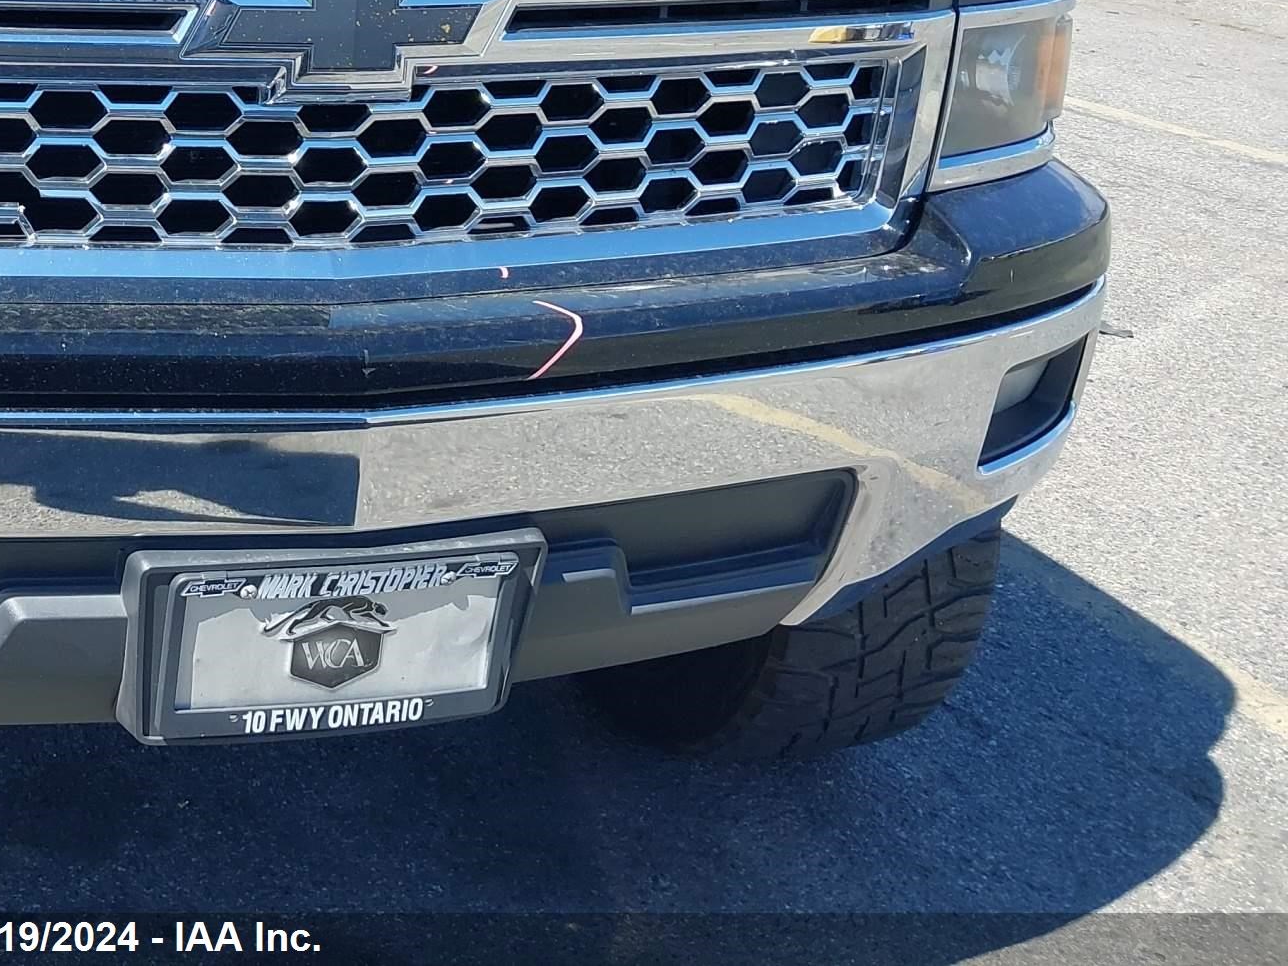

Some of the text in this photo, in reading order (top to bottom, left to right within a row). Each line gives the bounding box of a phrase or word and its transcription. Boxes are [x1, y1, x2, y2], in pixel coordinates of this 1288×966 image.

[465, 565, 510, 574] CHEVROLET
[190, 582, 239, 593] CHEVROLET
[256, 573, 317, 599] MARK
[302, 638, 364, 669] WCA
[242, 697, 424, 734] 10 FWY ONTARIO
